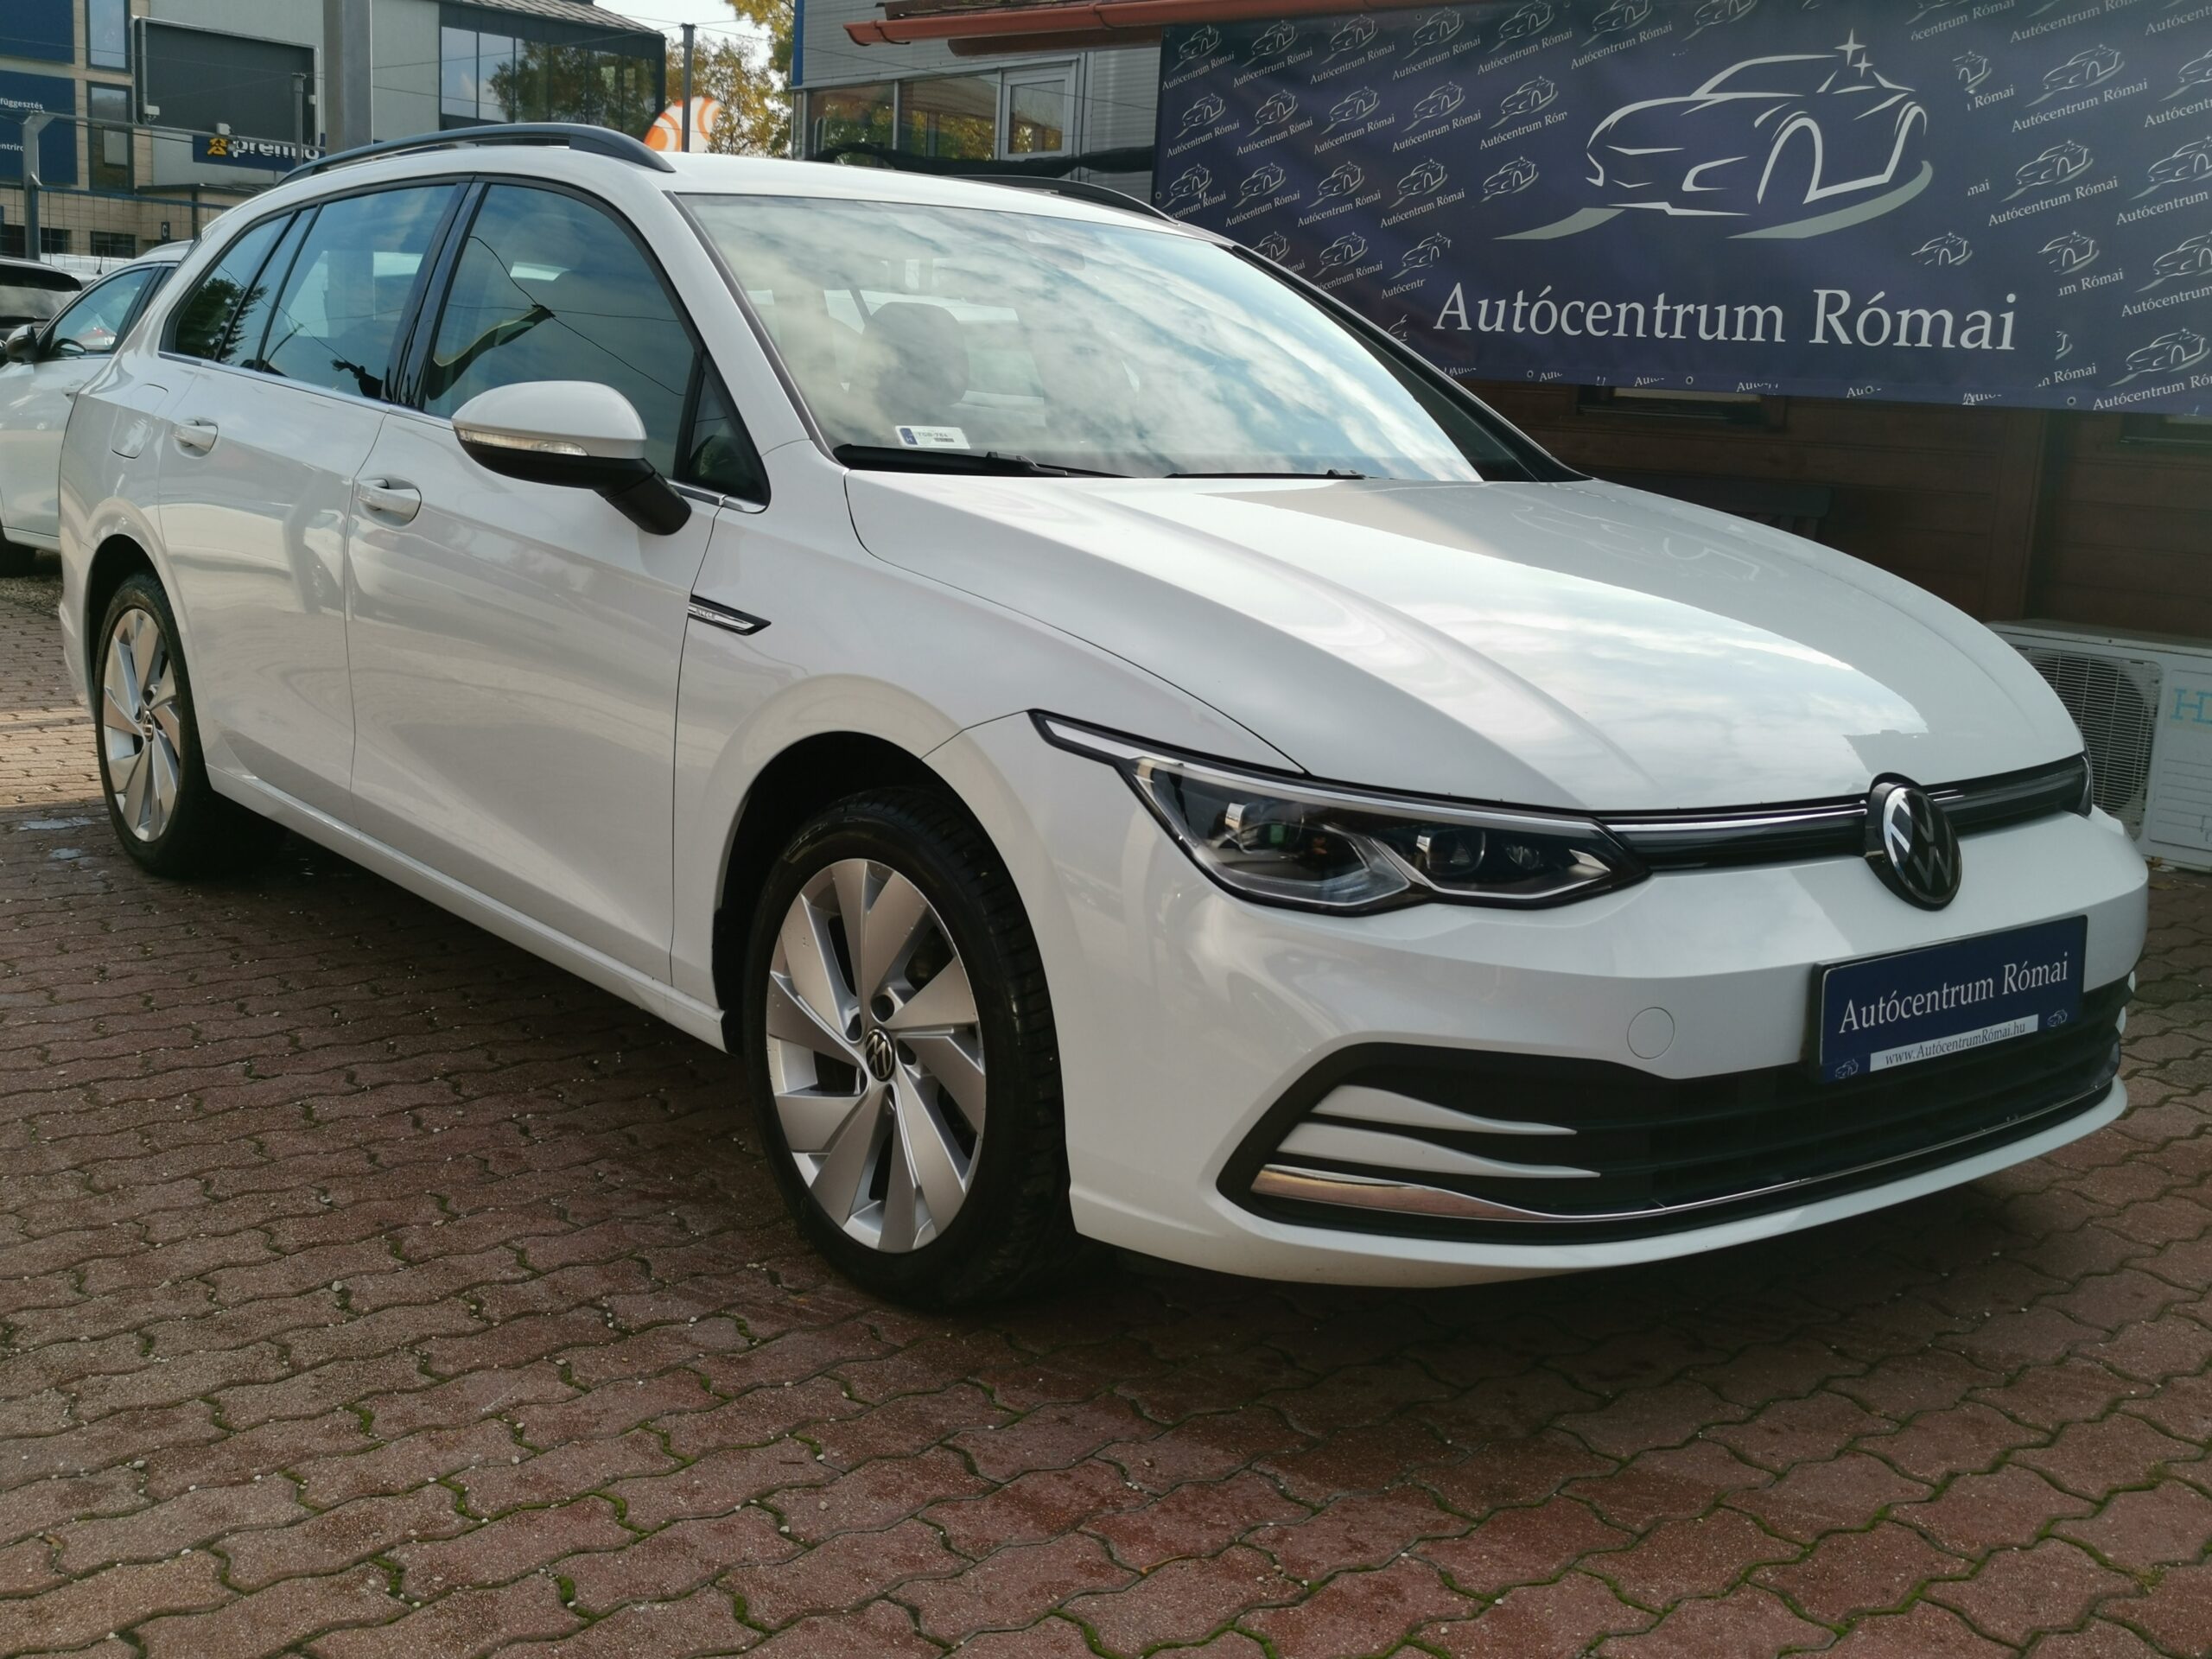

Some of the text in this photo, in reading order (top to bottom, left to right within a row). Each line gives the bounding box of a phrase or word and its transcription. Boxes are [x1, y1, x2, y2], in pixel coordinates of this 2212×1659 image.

[2011, 8, 2100, 43] Autócentrum
[1310, 43, 1395, 85] Autócentrum Római
[1392, 35, 1481, 81] Autócentrum Római
[1478, 29, 1573, 75] Autócentrum Római
[1571, 22, 1674, 69] Autócentrum Római
[1162, 52, 1235, 91] Autócentrum Római
[1233, 48, 1313, 88] Autócentrum Római
[1974, 84, 2015, 109] Római
[2012, 78, 2148, 132] Autócentrum Római
[232, 140, 321, 162] premo
[1166, 119, 1240, 158] Autócentrum Római
[1236, 117, 1313, 156] Autócentrum Római
[1313, 114, 1395, 156] Autócentrum Római
[1392, 110, 1482, 153] Autócentrum Római
[1479, 119, 1541, 150] Autócentrum
[1226, 190, 1300, 227] Autócentrum Római
[1298, 192, 1382, 228] Autócentrum Római
[1381, 188, 1465, 228] Autócentrum Római
[1988, 176, 2118, 226] Autócentrum Római
[2117, 191, 2209, 226] Autócentrum
[1356, 261, 1382, 278] Római
[2082, 268, 2124, 290] Római
[1434, 282, 2016, 351] Autócentrum Római
[2054, 363, 2096, 383] Római
[2093, 382, 2184, 410] Autócentrum
[1839, 951, 2069, 1033] Autócentrum Római
[1885, 1020, 2025, 1065] www.AutócentrumRómai.hu
